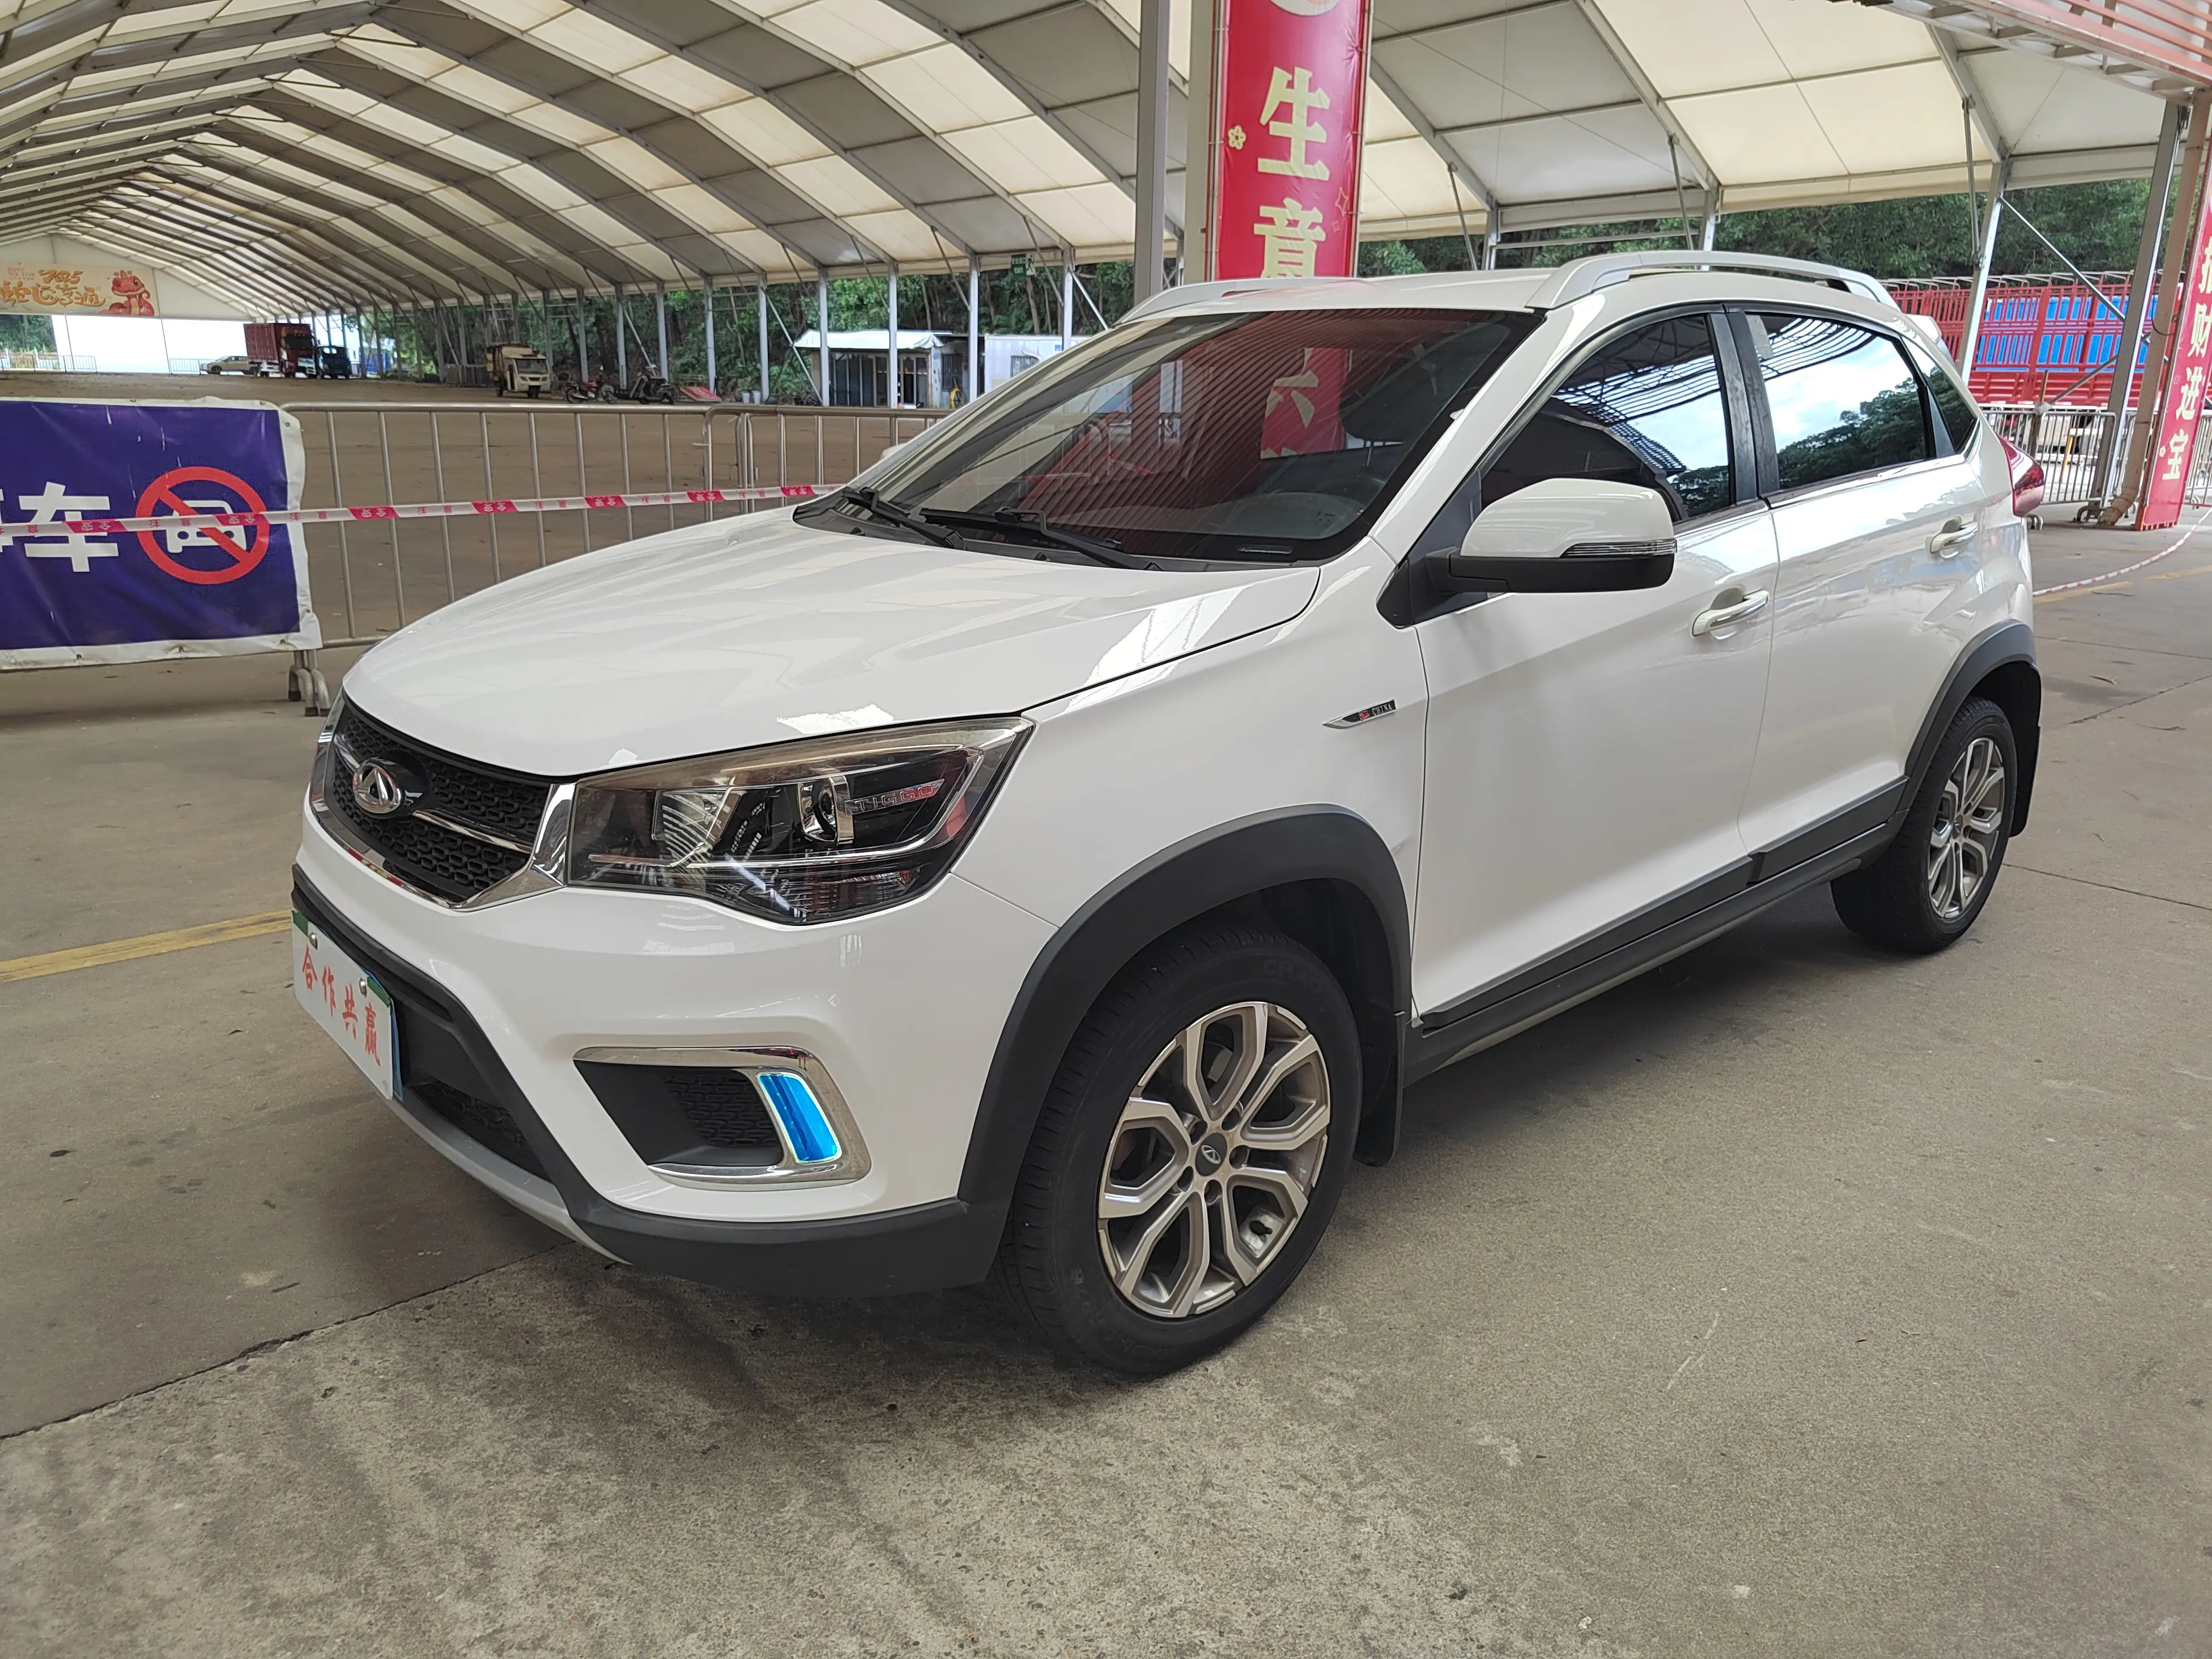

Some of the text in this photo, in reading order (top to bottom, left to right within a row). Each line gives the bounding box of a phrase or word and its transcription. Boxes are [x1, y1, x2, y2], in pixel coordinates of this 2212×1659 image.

[1253, 66, 1331, 278] 生意
[0, 482, 119, 572] 车
[1372, 704, 1393, 716] CHINA
[854, 785, 933, 812] TIGGO
[302, 945, 381, 1066] 合作共赢
